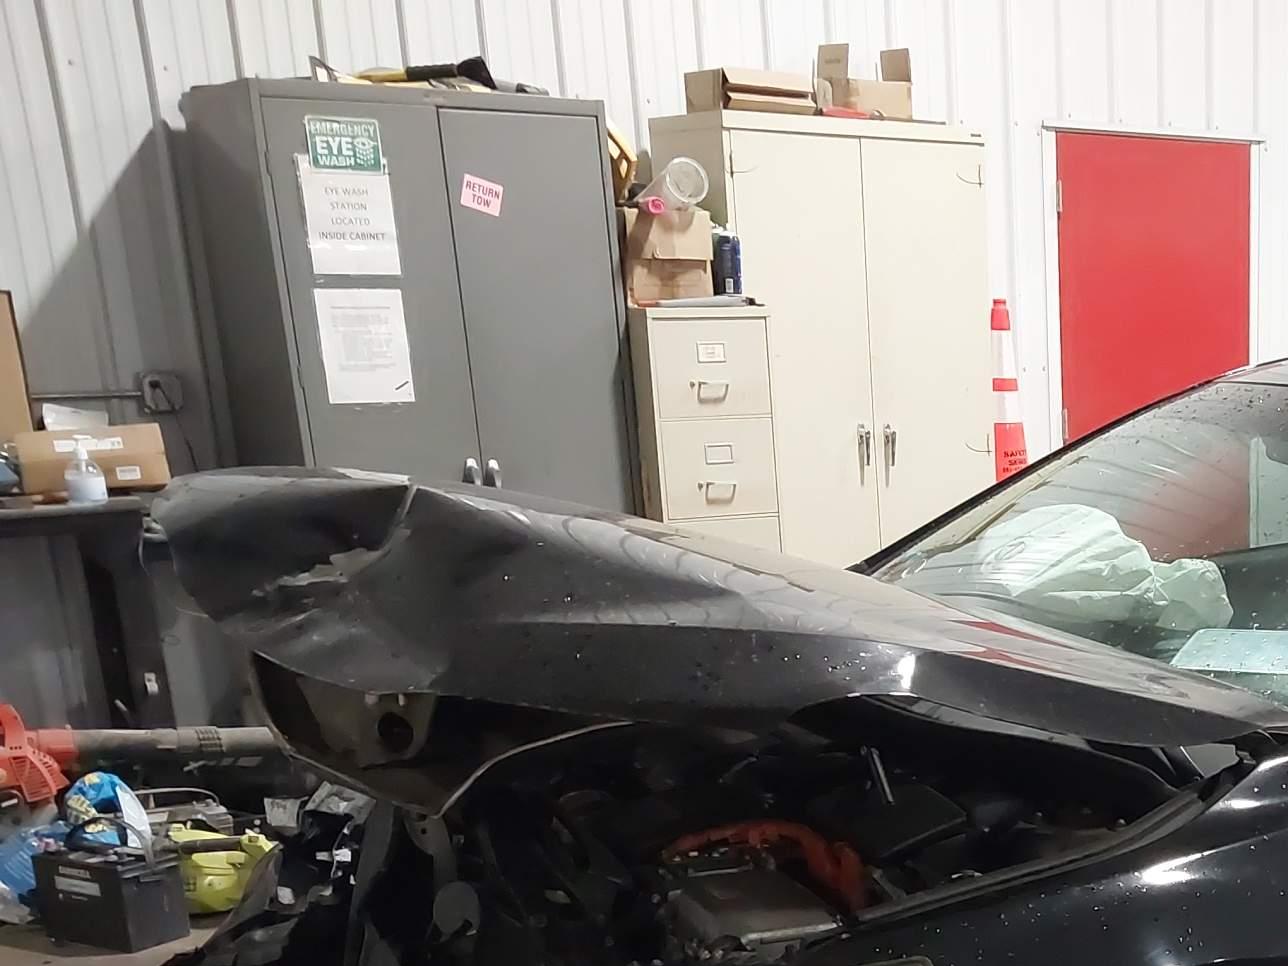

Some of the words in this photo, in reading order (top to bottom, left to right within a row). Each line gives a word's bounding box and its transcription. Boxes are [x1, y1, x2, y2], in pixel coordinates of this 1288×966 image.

[309, 120, 375, 137] EMERGENCY
[315, 135, 354, 156] EYE
[317, 154, 355, 167] WASH
[324, 186, 339, 197] EYE
[341, 186, 369, 197] WASH
[465, 180, 500, 200] RETURN
[329, 201, 368, 211] STATION
[472, 193, 492, 209] TOW
[330, 216, 370, 226] LOCATED
[318, 231, 346, 241] INSIDE
[348, 232, 386, 242] CABINET
